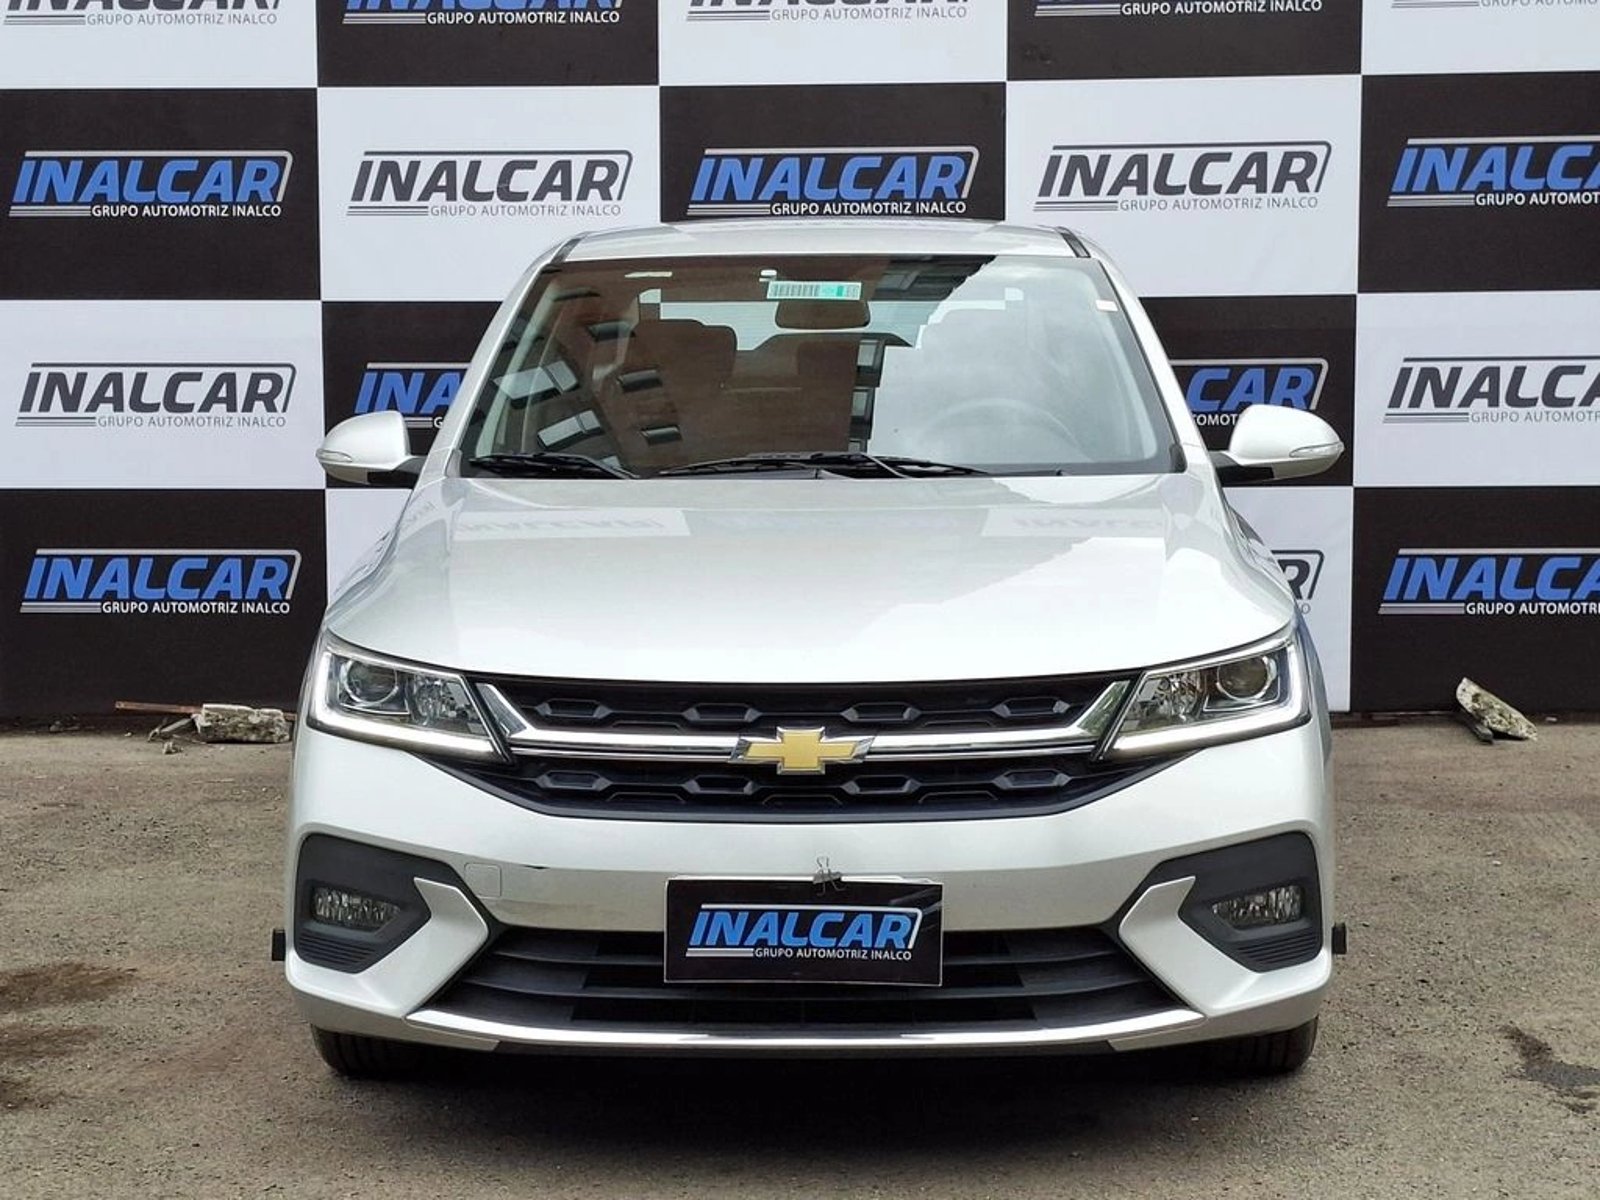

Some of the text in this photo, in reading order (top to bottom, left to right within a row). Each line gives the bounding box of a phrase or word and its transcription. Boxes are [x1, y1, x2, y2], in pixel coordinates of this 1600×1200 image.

[771, 6, 967, 20] GRUPO AUTOMOTRIZ INALCO
[1121, 0, 1322, 15] GRUPO AUTOMOTRIZ INALCO
[87, 13, 277, 25] GRUPO AUTOMOTRIZ INALCO
[427, 11, 619, 24] GRUPO AUTOMOTRIZ INALCO
[692, 156, 966, 201] INALCAR
[1038, 151, 1318, 197] INALCAR
[14, 160, 280, 203] INALCAR
[351, 160, 620, 203] INALCAR
[1119, 197, 1318, 212] GRUPO AUTOMOTRIZ INALCO
[1476, 193, 1525, 206] GRUPO
[91, 205, 282, 217] GRUPO AUTOMOTRIZ INALCO
[430, 205, 621, 217] GRUPO AUTOMOTRIZ INALCO
[771, 201, 967, 215] GRUPO AUTOMOTRIZ INALCO
[19, 372, 284, 413] INALCAR
[98, 416, 287, 428] GRUPO AUTOMOTRIZ INALCO
[1471, 411, 1520, 423] GRUPO
[25, 558, 290, 600] INALCAR
[102, 602, 290, 614] GRUPO AUTOMOTRIZ INALCO
[1466, 602, 1514, 615] GRUPO
[689, 911, 912, 949] INALCAR
[754, 947, 912, 961] GRUPO AUTOMOTRIZ INALCO
